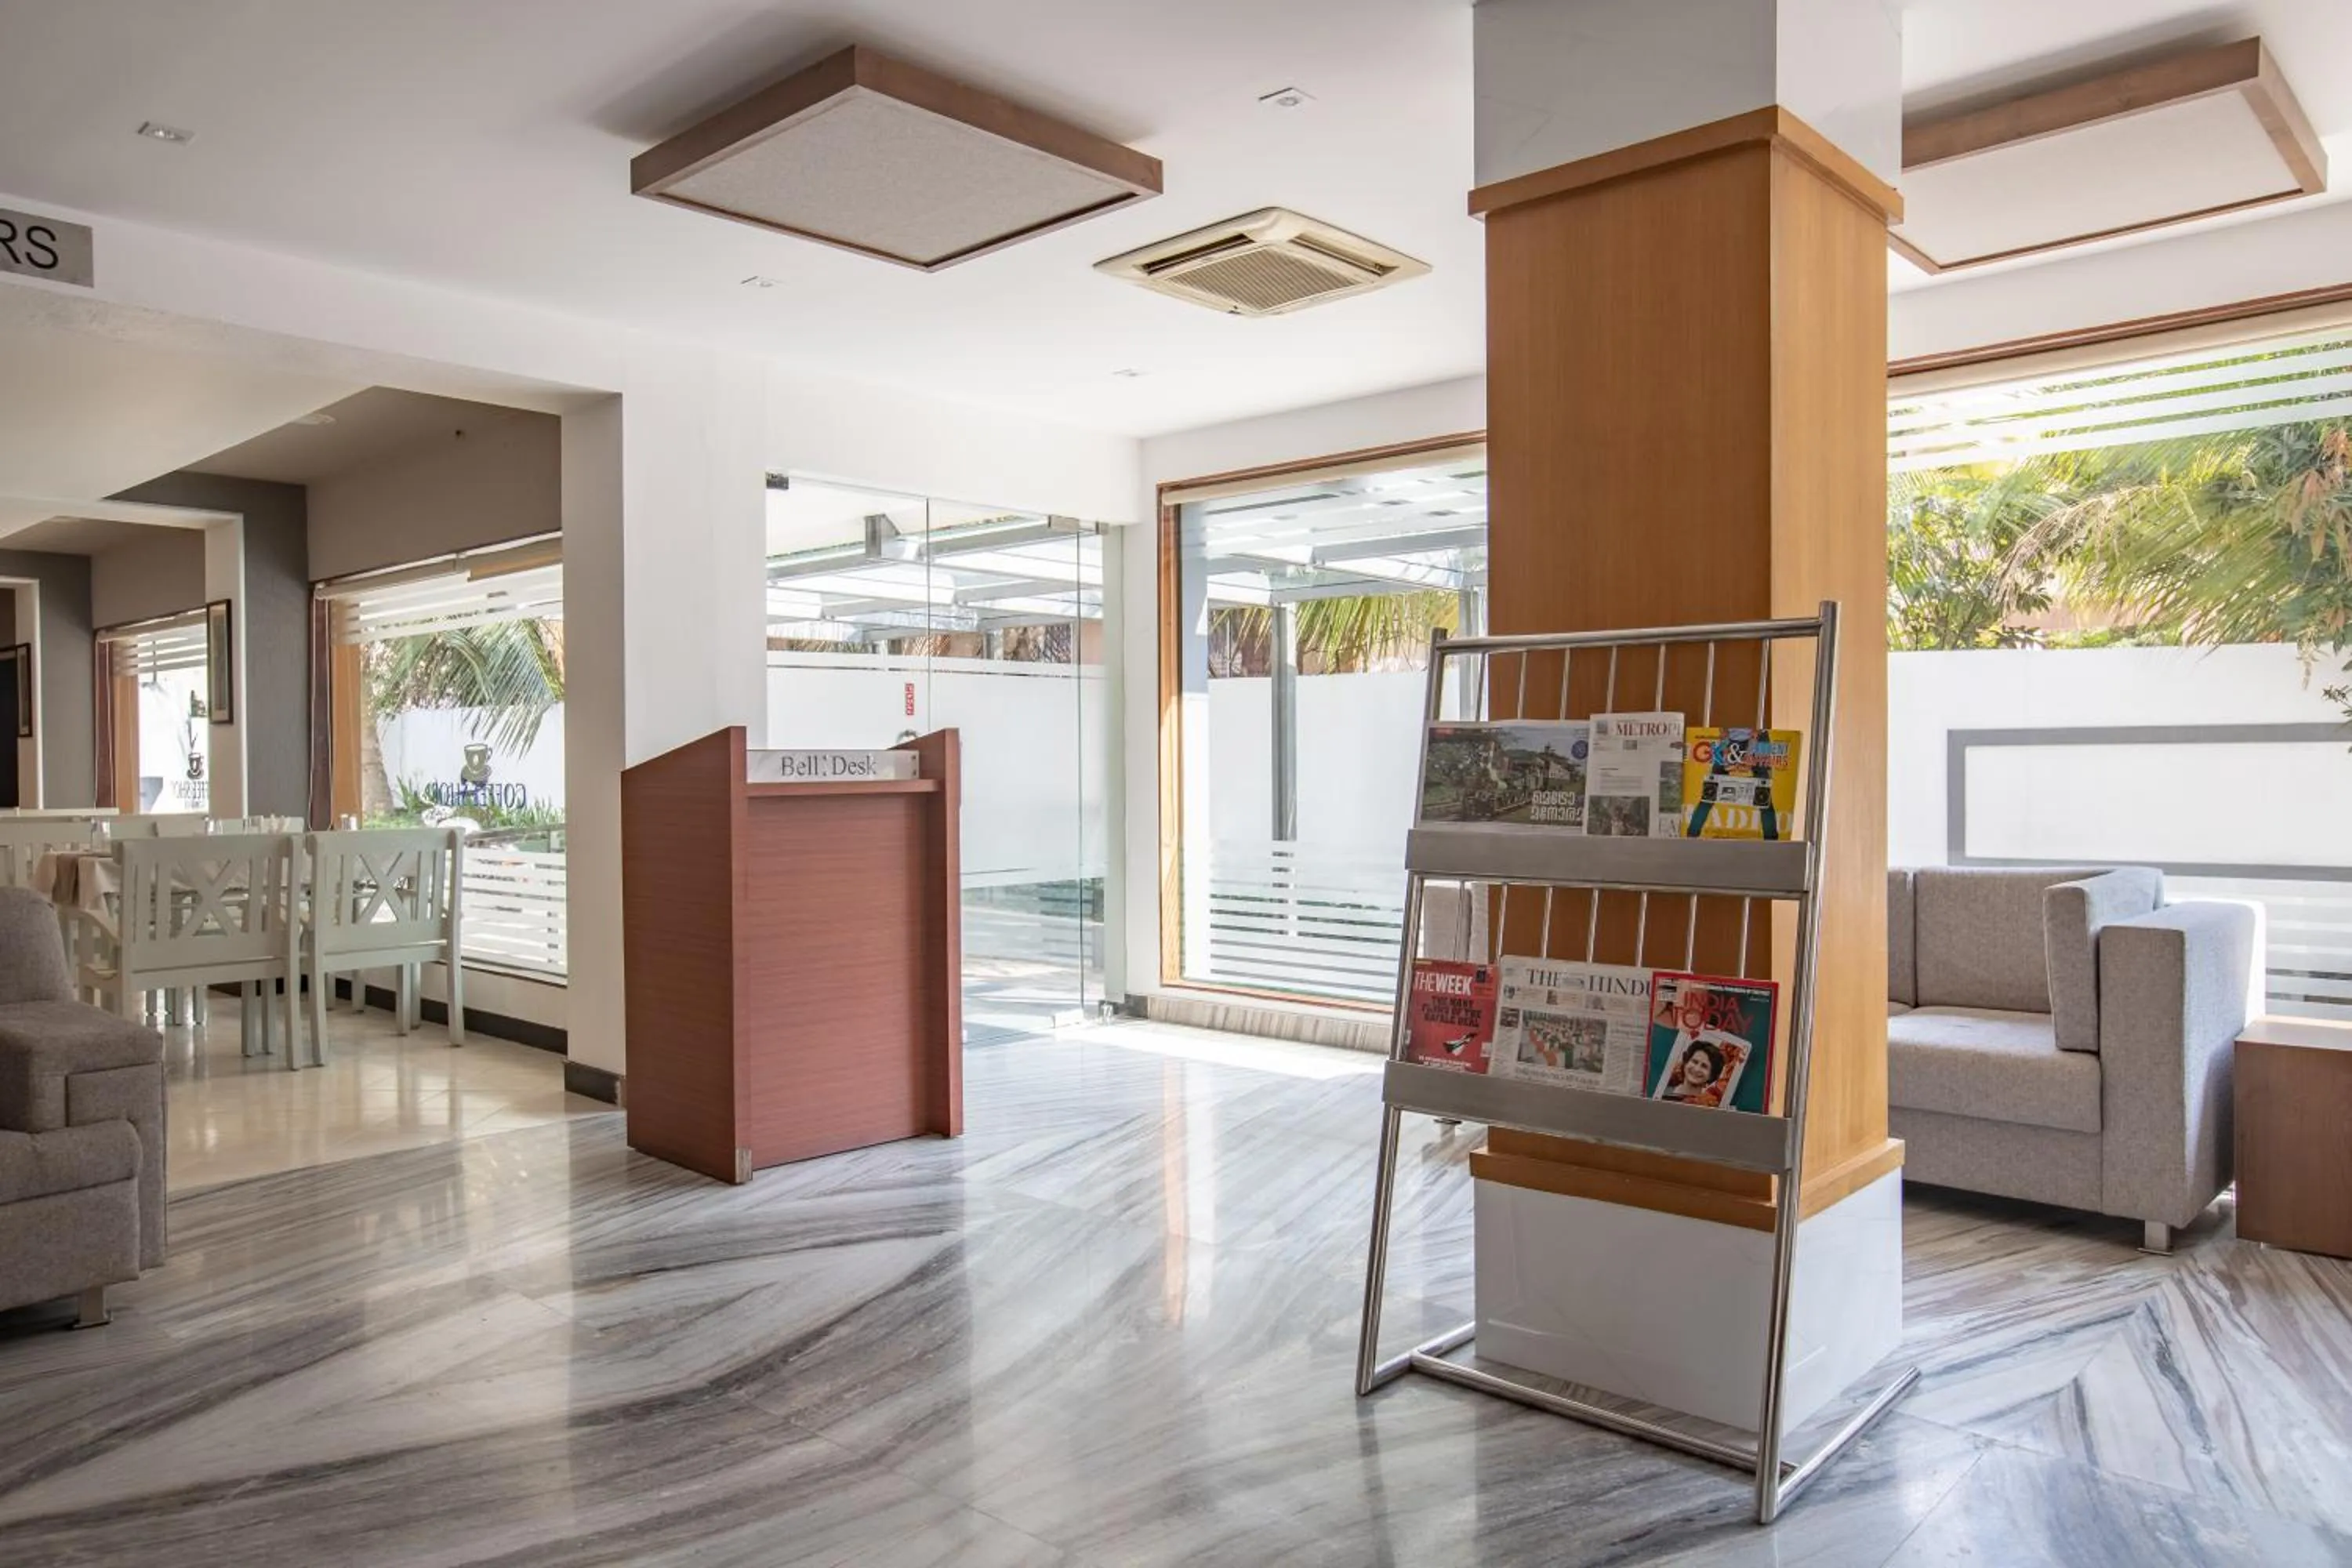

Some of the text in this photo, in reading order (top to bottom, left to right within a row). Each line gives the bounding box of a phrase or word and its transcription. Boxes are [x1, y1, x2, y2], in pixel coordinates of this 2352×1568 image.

[781, 754, 877, 777] Bell Desk
[1435, 973, 1474, 996] WEEK
[1527, 967, 1559, 987] THE
[1684, 991, 1740, 1011] INDIA
[1674, 1006, 1755, 1035] TODAY
